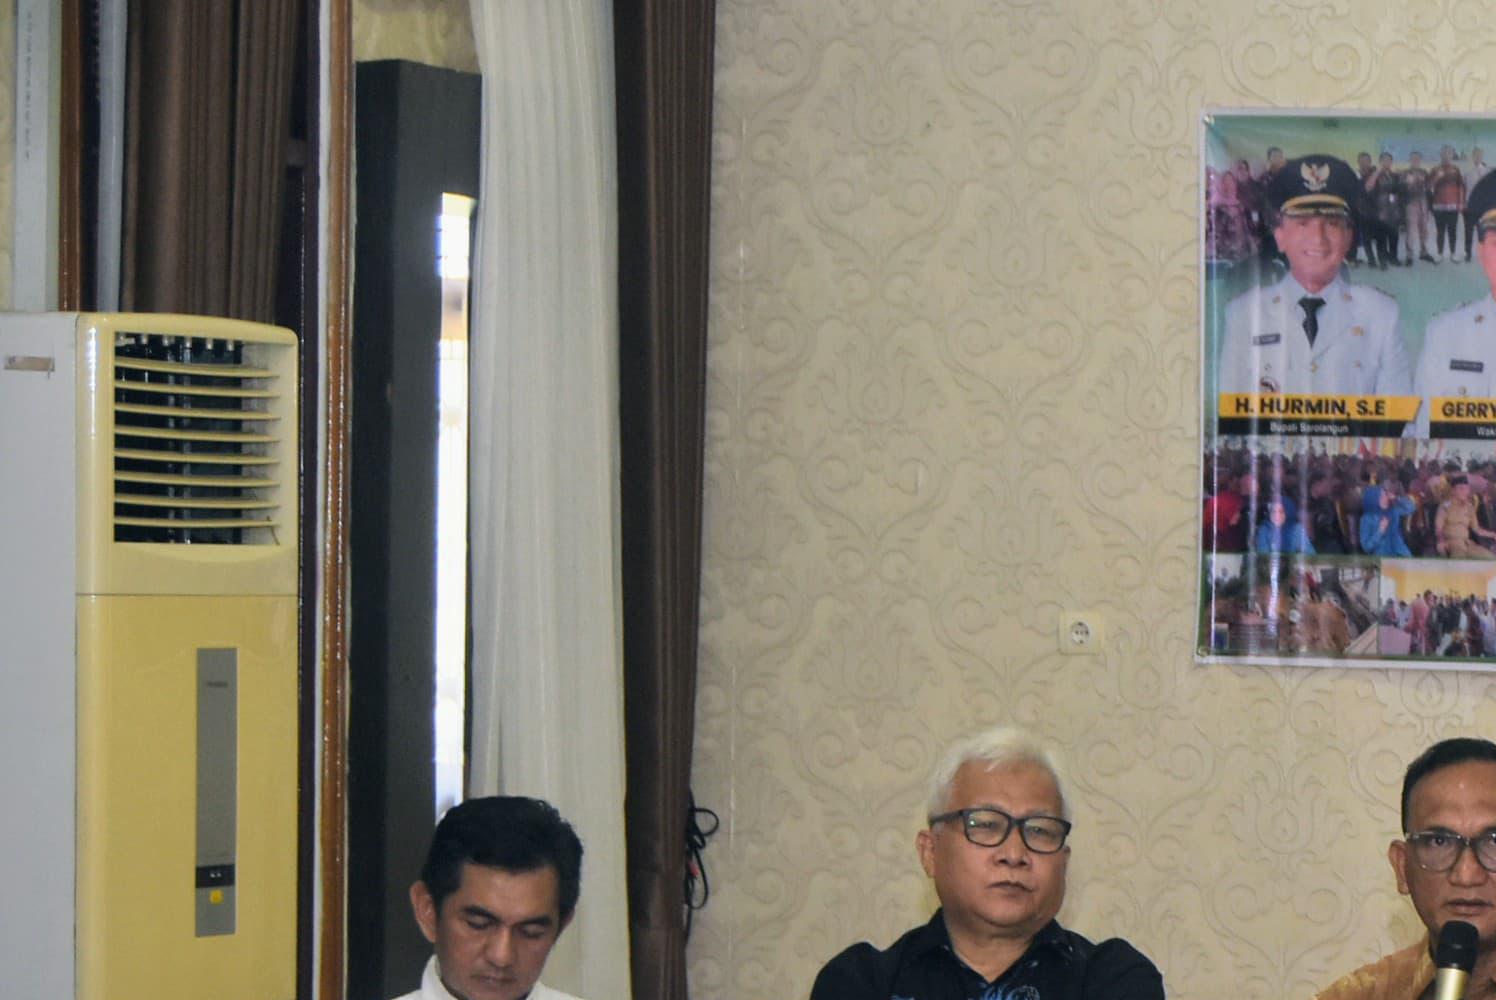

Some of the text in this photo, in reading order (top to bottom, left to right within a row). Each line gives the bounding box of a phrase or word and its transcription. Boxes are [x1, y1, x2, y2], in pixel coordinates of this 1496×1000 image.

[1235, 397, 1386, 417] H. HURMIN, S.E
[1269, 421, 1349, 435] Bupati Sarolangun
